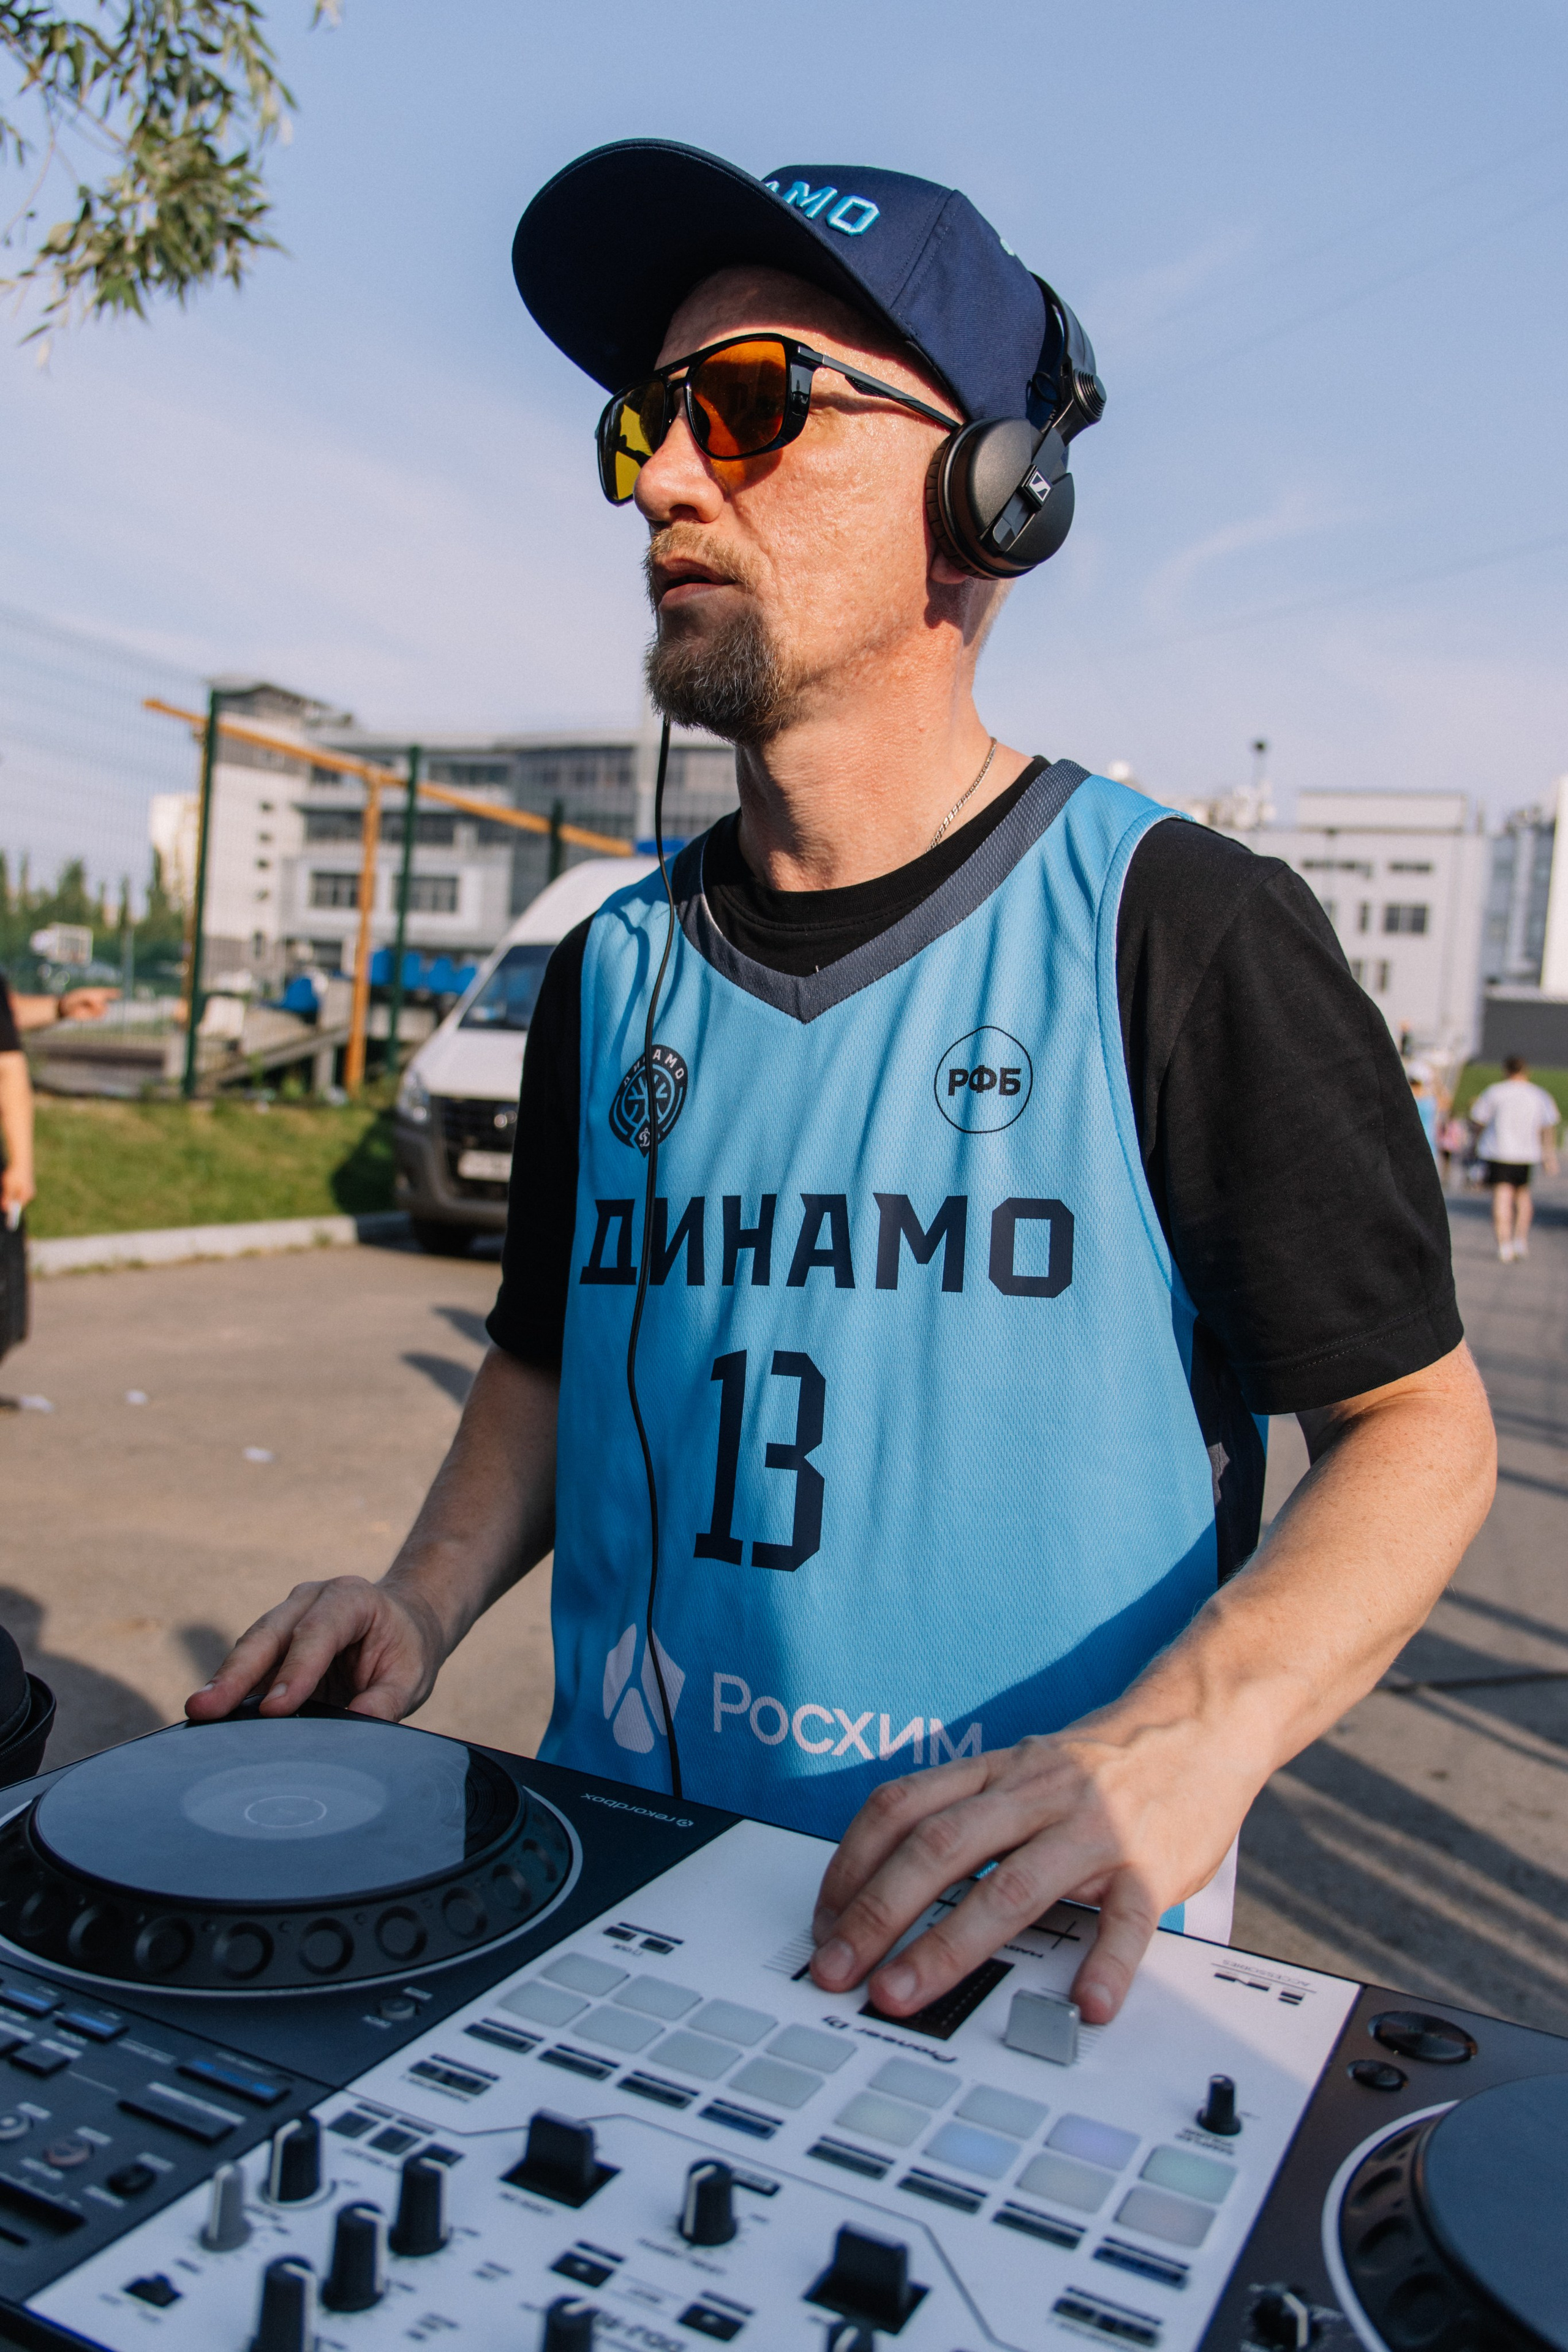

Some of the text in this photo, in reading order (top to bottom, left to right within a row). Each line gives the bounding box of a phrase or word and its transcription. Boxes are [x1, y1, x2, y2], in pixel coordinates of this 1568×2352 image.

[624, 1049, 685, 1088] ДИАМО
[948, 1065, 1022, 1096] РФБ
[579, 1193, 1075, 1298] ДИНАМО
[693, 1349, 826, 1572] 13
[581, 1793, 676, 1823] rekordbox
